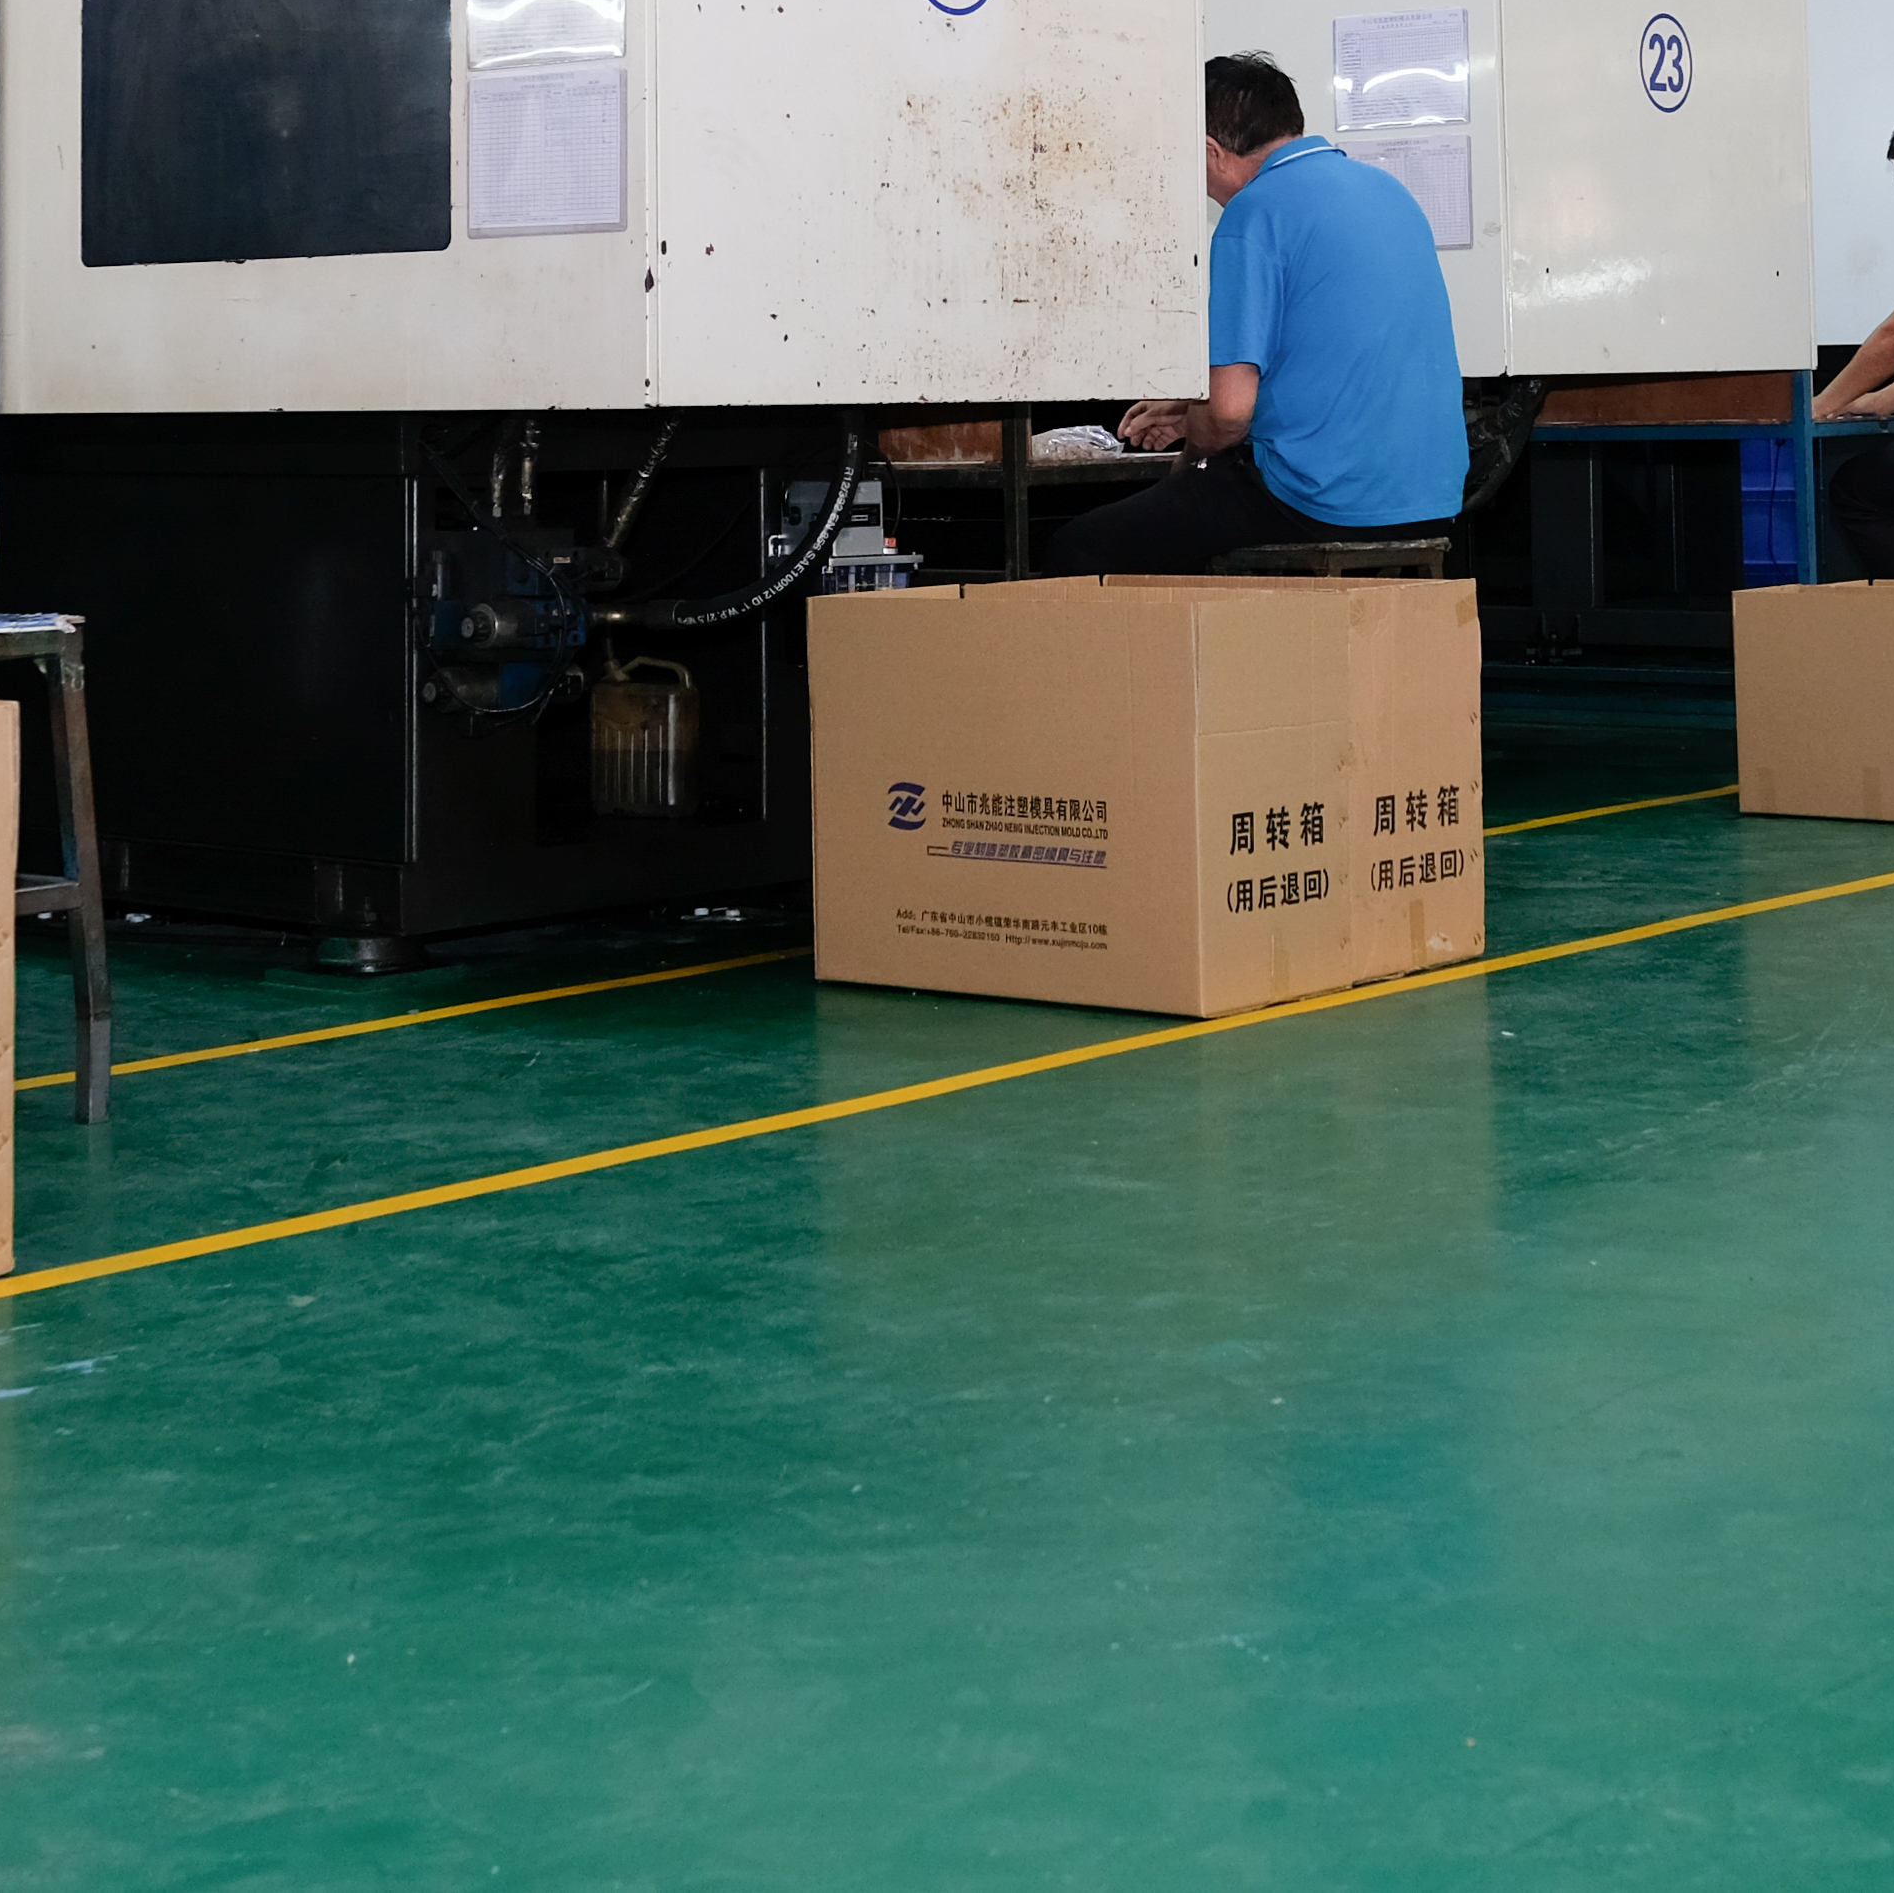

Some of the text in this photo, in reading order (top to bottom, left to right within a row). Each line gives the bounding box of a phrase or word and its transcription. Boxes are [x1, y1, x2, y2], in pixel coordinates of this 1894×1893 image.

[1647, 33, 1685, 93] 23
[763, 550, 815, 599] SAE100R12
[751, 594, 763, 606] ID
[941, 790, 1107, 824] 中山市兆能注塑模具有限公司
[942, 817, 965, 830] ZHONG
[966, 819, 984, 831] SHAN
[985, 820, 1003, 832] ZHAO
[1024, 823, 1060, 837] INJECTION
[1061, 826, 1081, 838] MOLD
[1229, 802, 1326, 856] 周转箱
[1372, 785, 1461, 837] 周转箱
[1226, 868, 1330, 914] (用后退回)
[1370, 849, 1465, 893] (用后退回)
